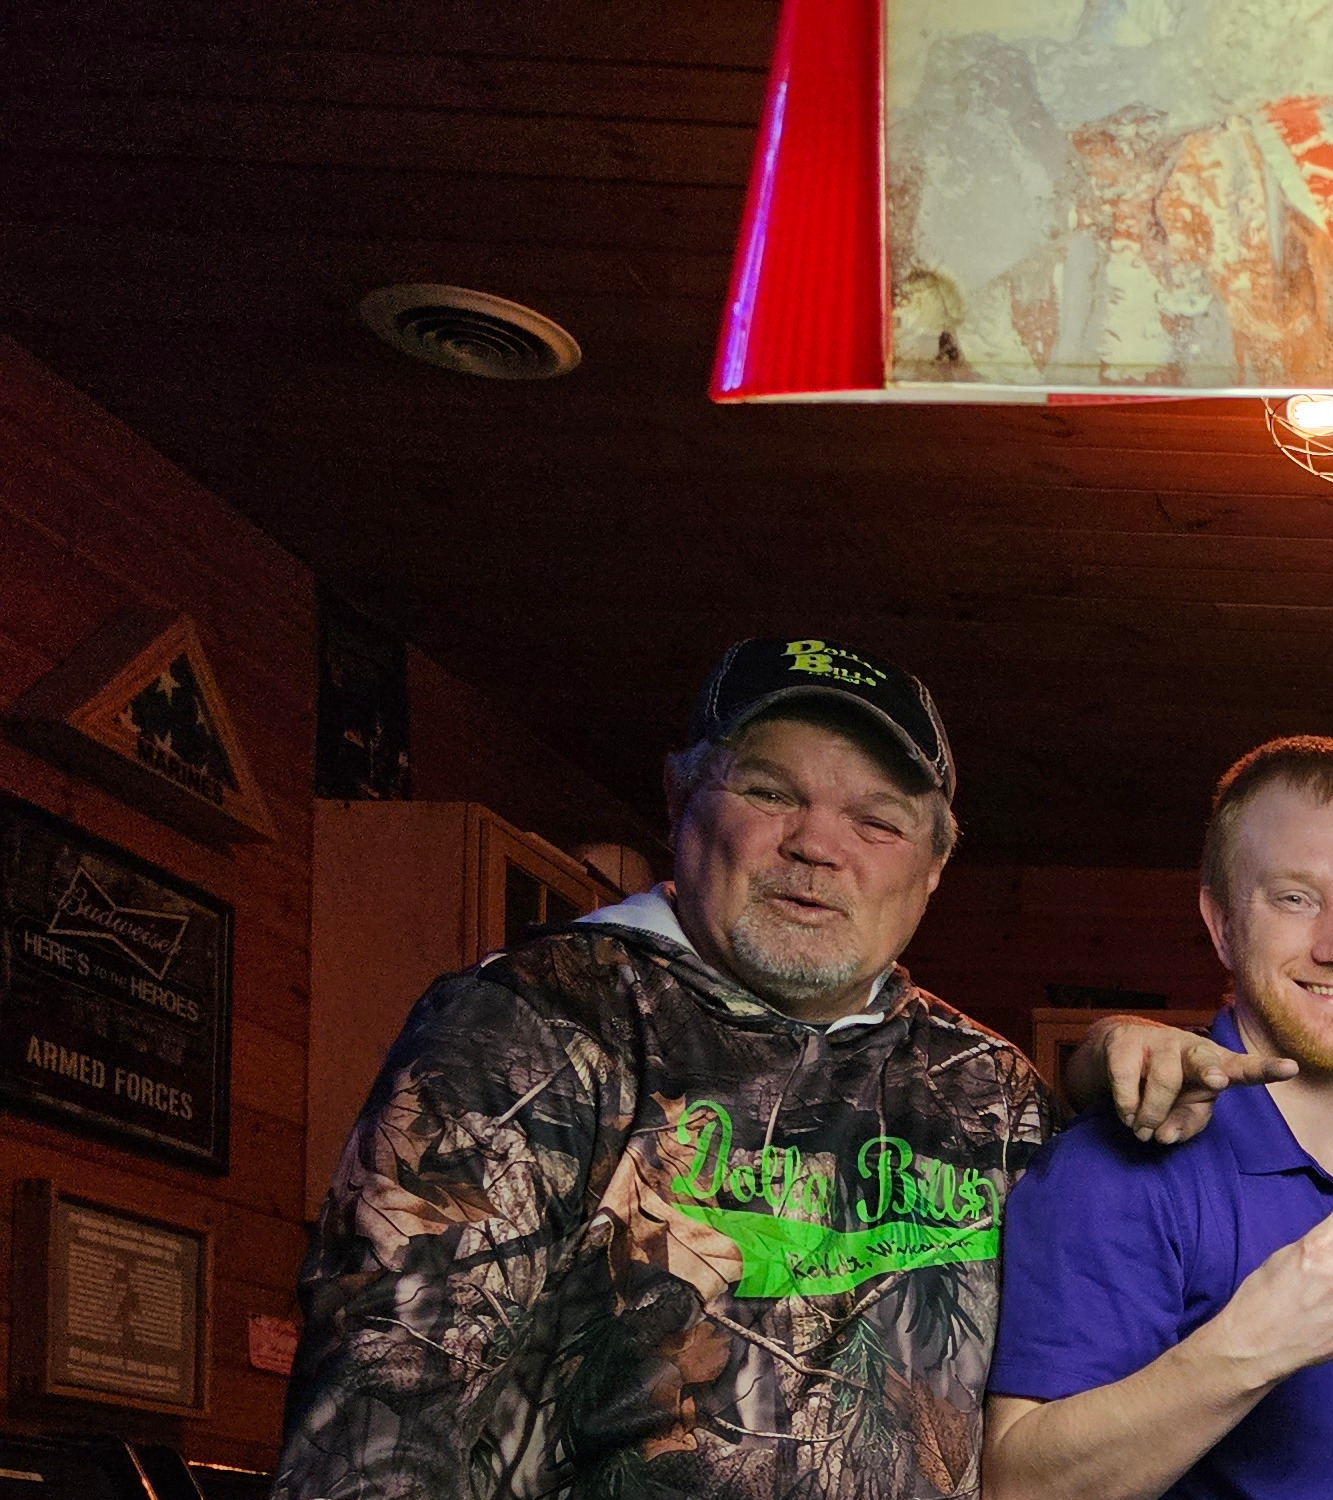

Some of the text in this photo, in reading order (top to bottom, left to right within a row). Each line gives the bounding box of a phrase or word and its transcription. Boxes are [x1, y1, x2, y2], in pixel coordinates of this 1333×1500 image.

[23, 929, 91, 977] HERE'S
[129, 975, 200, 1023] HEROES
[26, 1034, 194, 1121] ARMED FORCES
